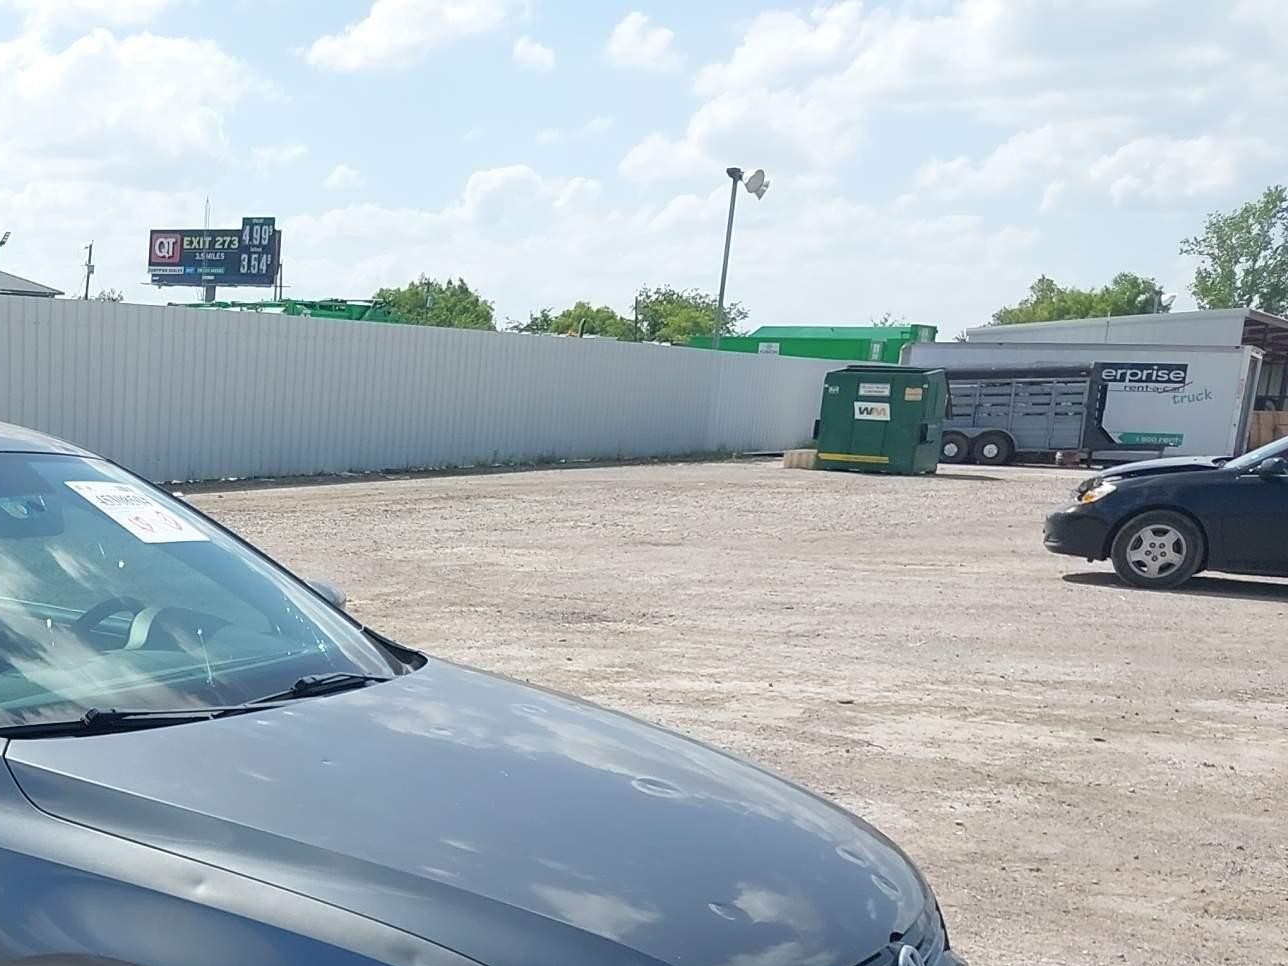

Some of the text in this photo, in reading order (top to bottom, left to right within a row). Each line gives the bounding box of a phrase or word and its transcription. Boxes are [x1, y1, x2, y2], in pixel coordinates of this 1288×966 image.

[154, 238, 176, 258] QT
[183, 236, 239, 249] EXIT 273
[206, 252, 224, 260] MILES
[1172, 389, 1213, 405] truck
[858, 406, 886, 417] WM
